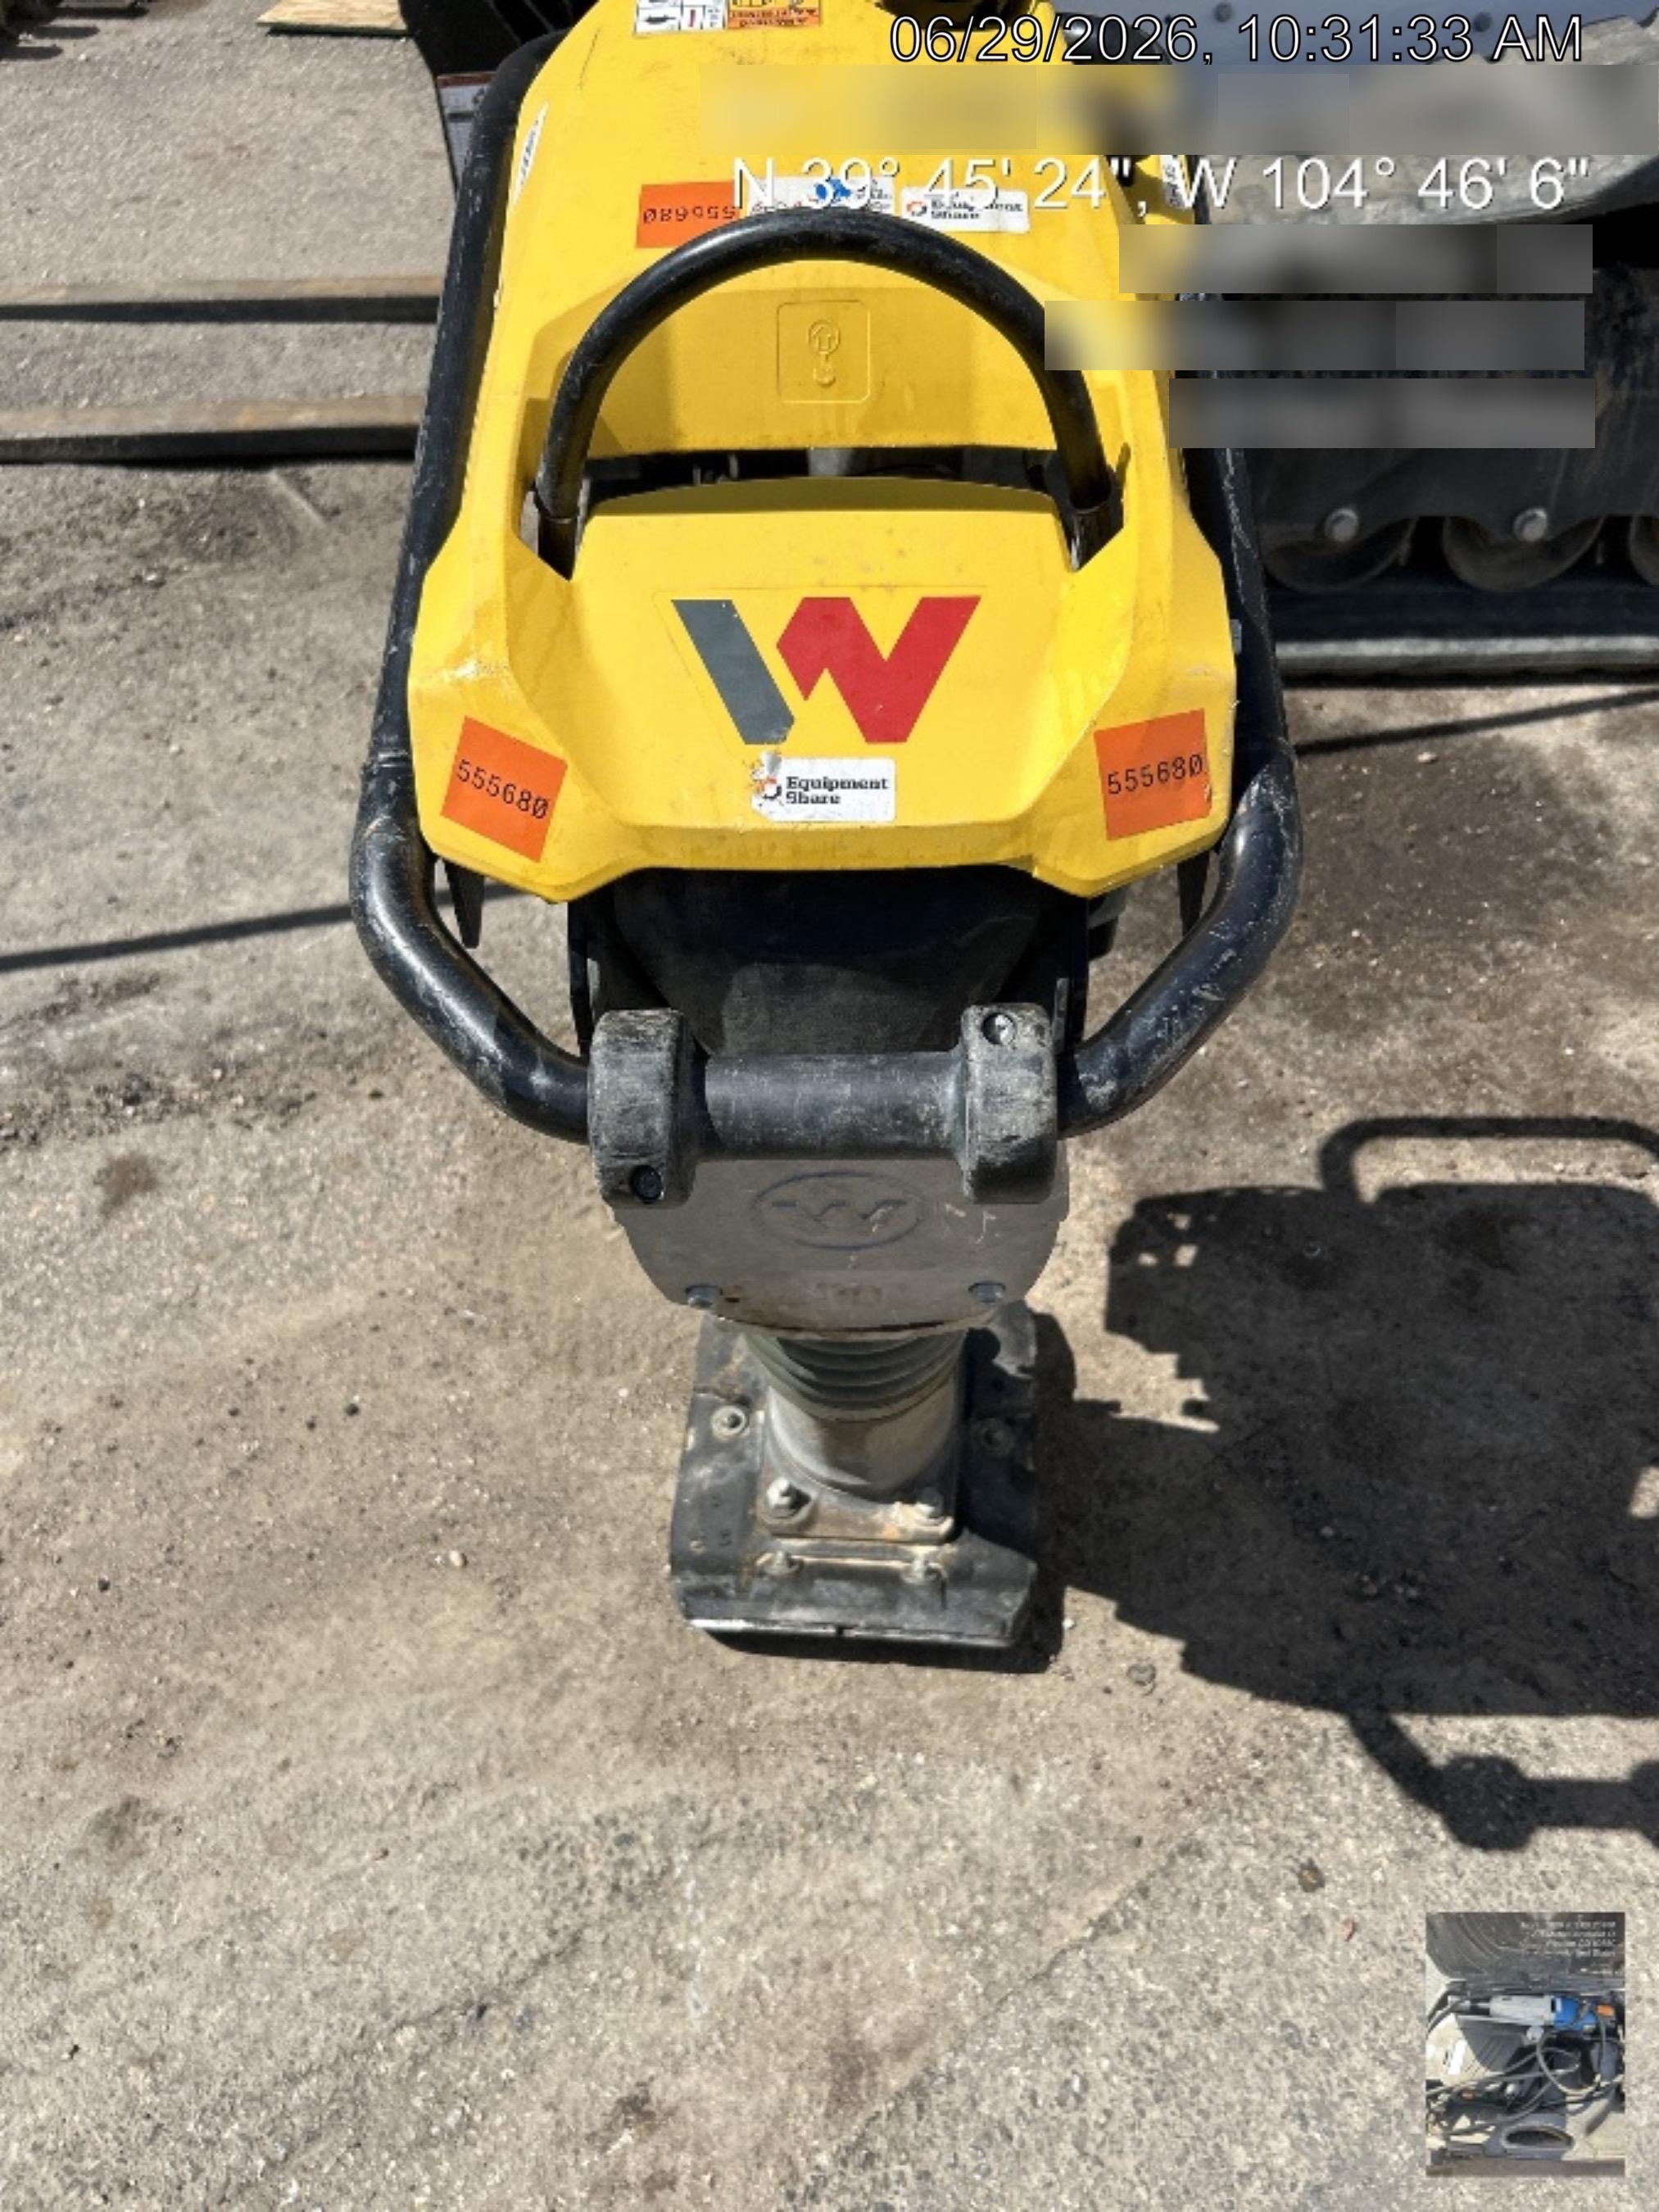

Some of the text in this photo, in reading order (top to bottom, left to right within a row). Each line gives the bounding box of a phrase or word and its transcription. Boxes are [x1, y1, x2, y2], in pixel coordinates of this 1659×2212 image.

[786, 777, 888, 791] Equipment
[1108, 754, 1203, 795] 555680
[456, 759, 549, 819] 555680
[786, 791, 841, 805] Share
